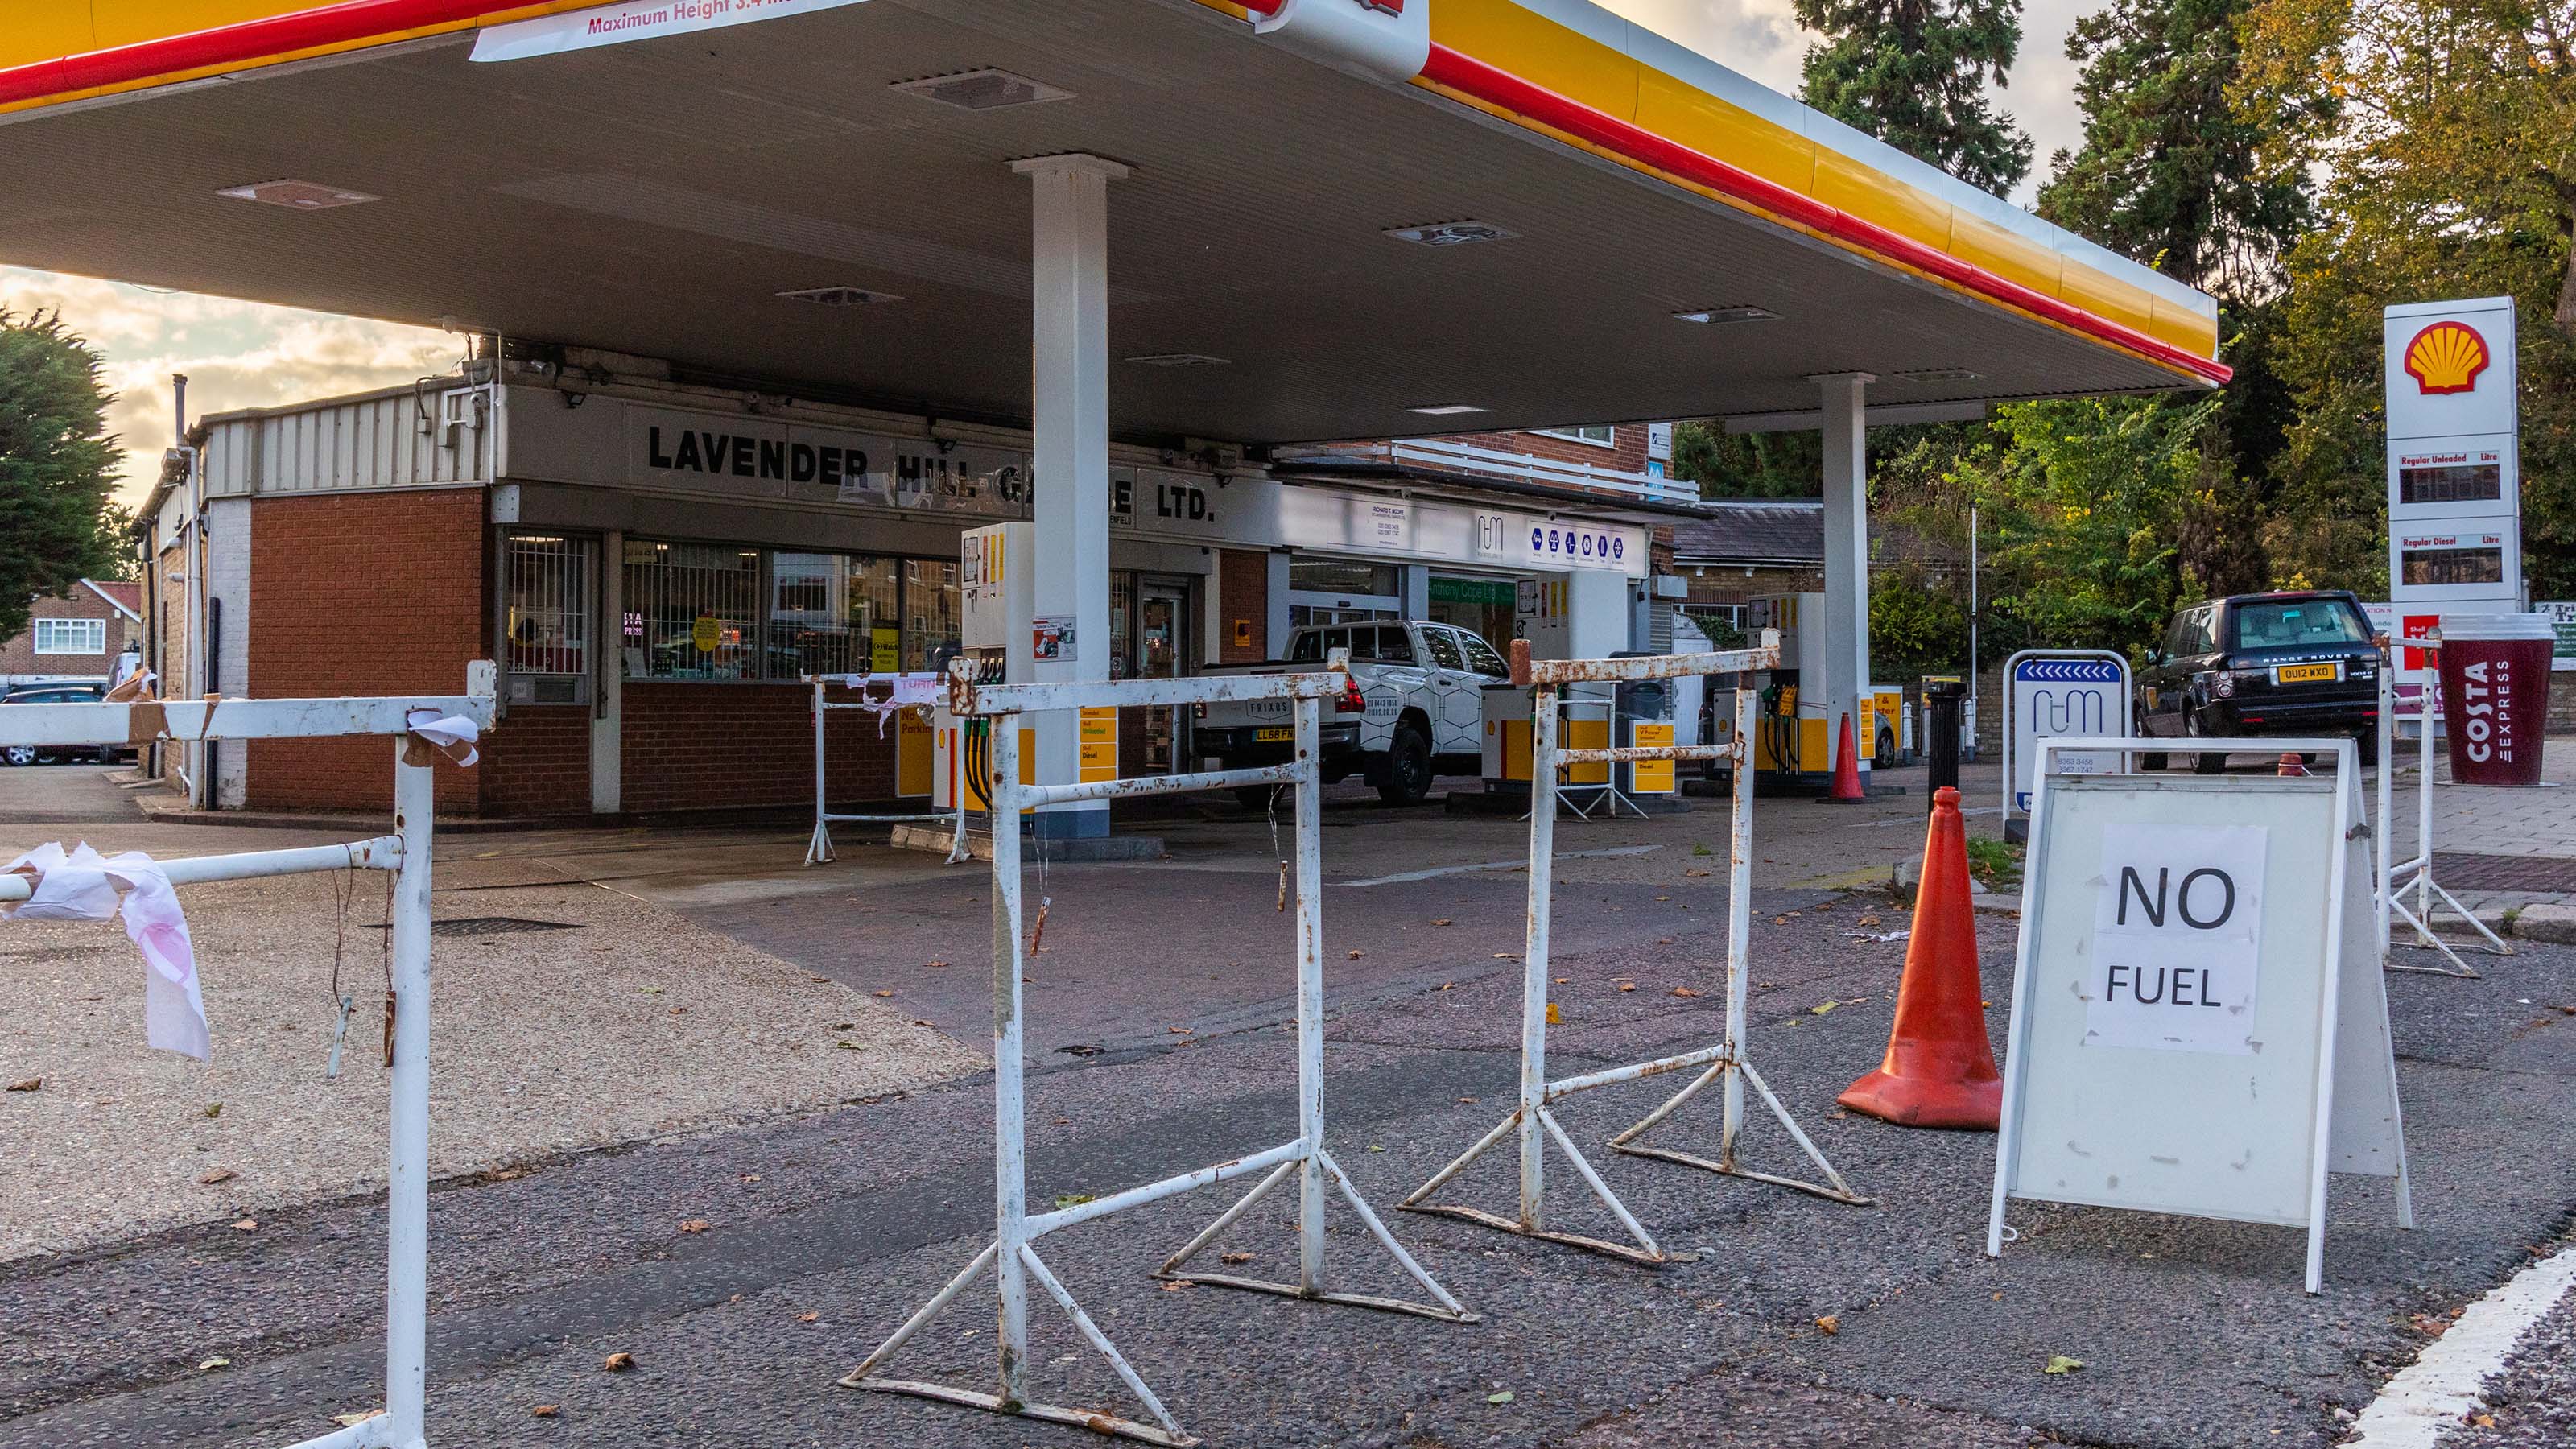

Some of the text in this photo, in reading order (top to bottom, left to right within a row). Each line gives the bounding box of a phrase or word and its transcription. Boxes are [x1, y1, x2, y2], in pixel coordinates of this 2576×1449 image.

[588, 11, 668, 35] Maximum
[673, 0, 729, 20] Height
[2401, 452, 2498, 467] Regular Unleaded Litre
[648, 426, 869, 489] LAVENDER
[898, 454, 976, 498] HILL
[1157, 484, 1215, 522] LTD.
[2403, 535, 2500, 548] Regular Diesel Litre
[2285, 667, 2329, 679] OU12 WXO
[1250, 701, 1287, 713] FRIXOS
[2496, 660, 2512, 747] EXPRESS
[902, 710, 915, 720] No
[2463, 661, 2493, 762] COSTA
[1257, 729, 1295, 740] LL68 FN
[1082, 751, 1098, 759] Diesel
[2116, 865, 2235, 930] NO
[2106, 964, 2222, 1007] FUEL
